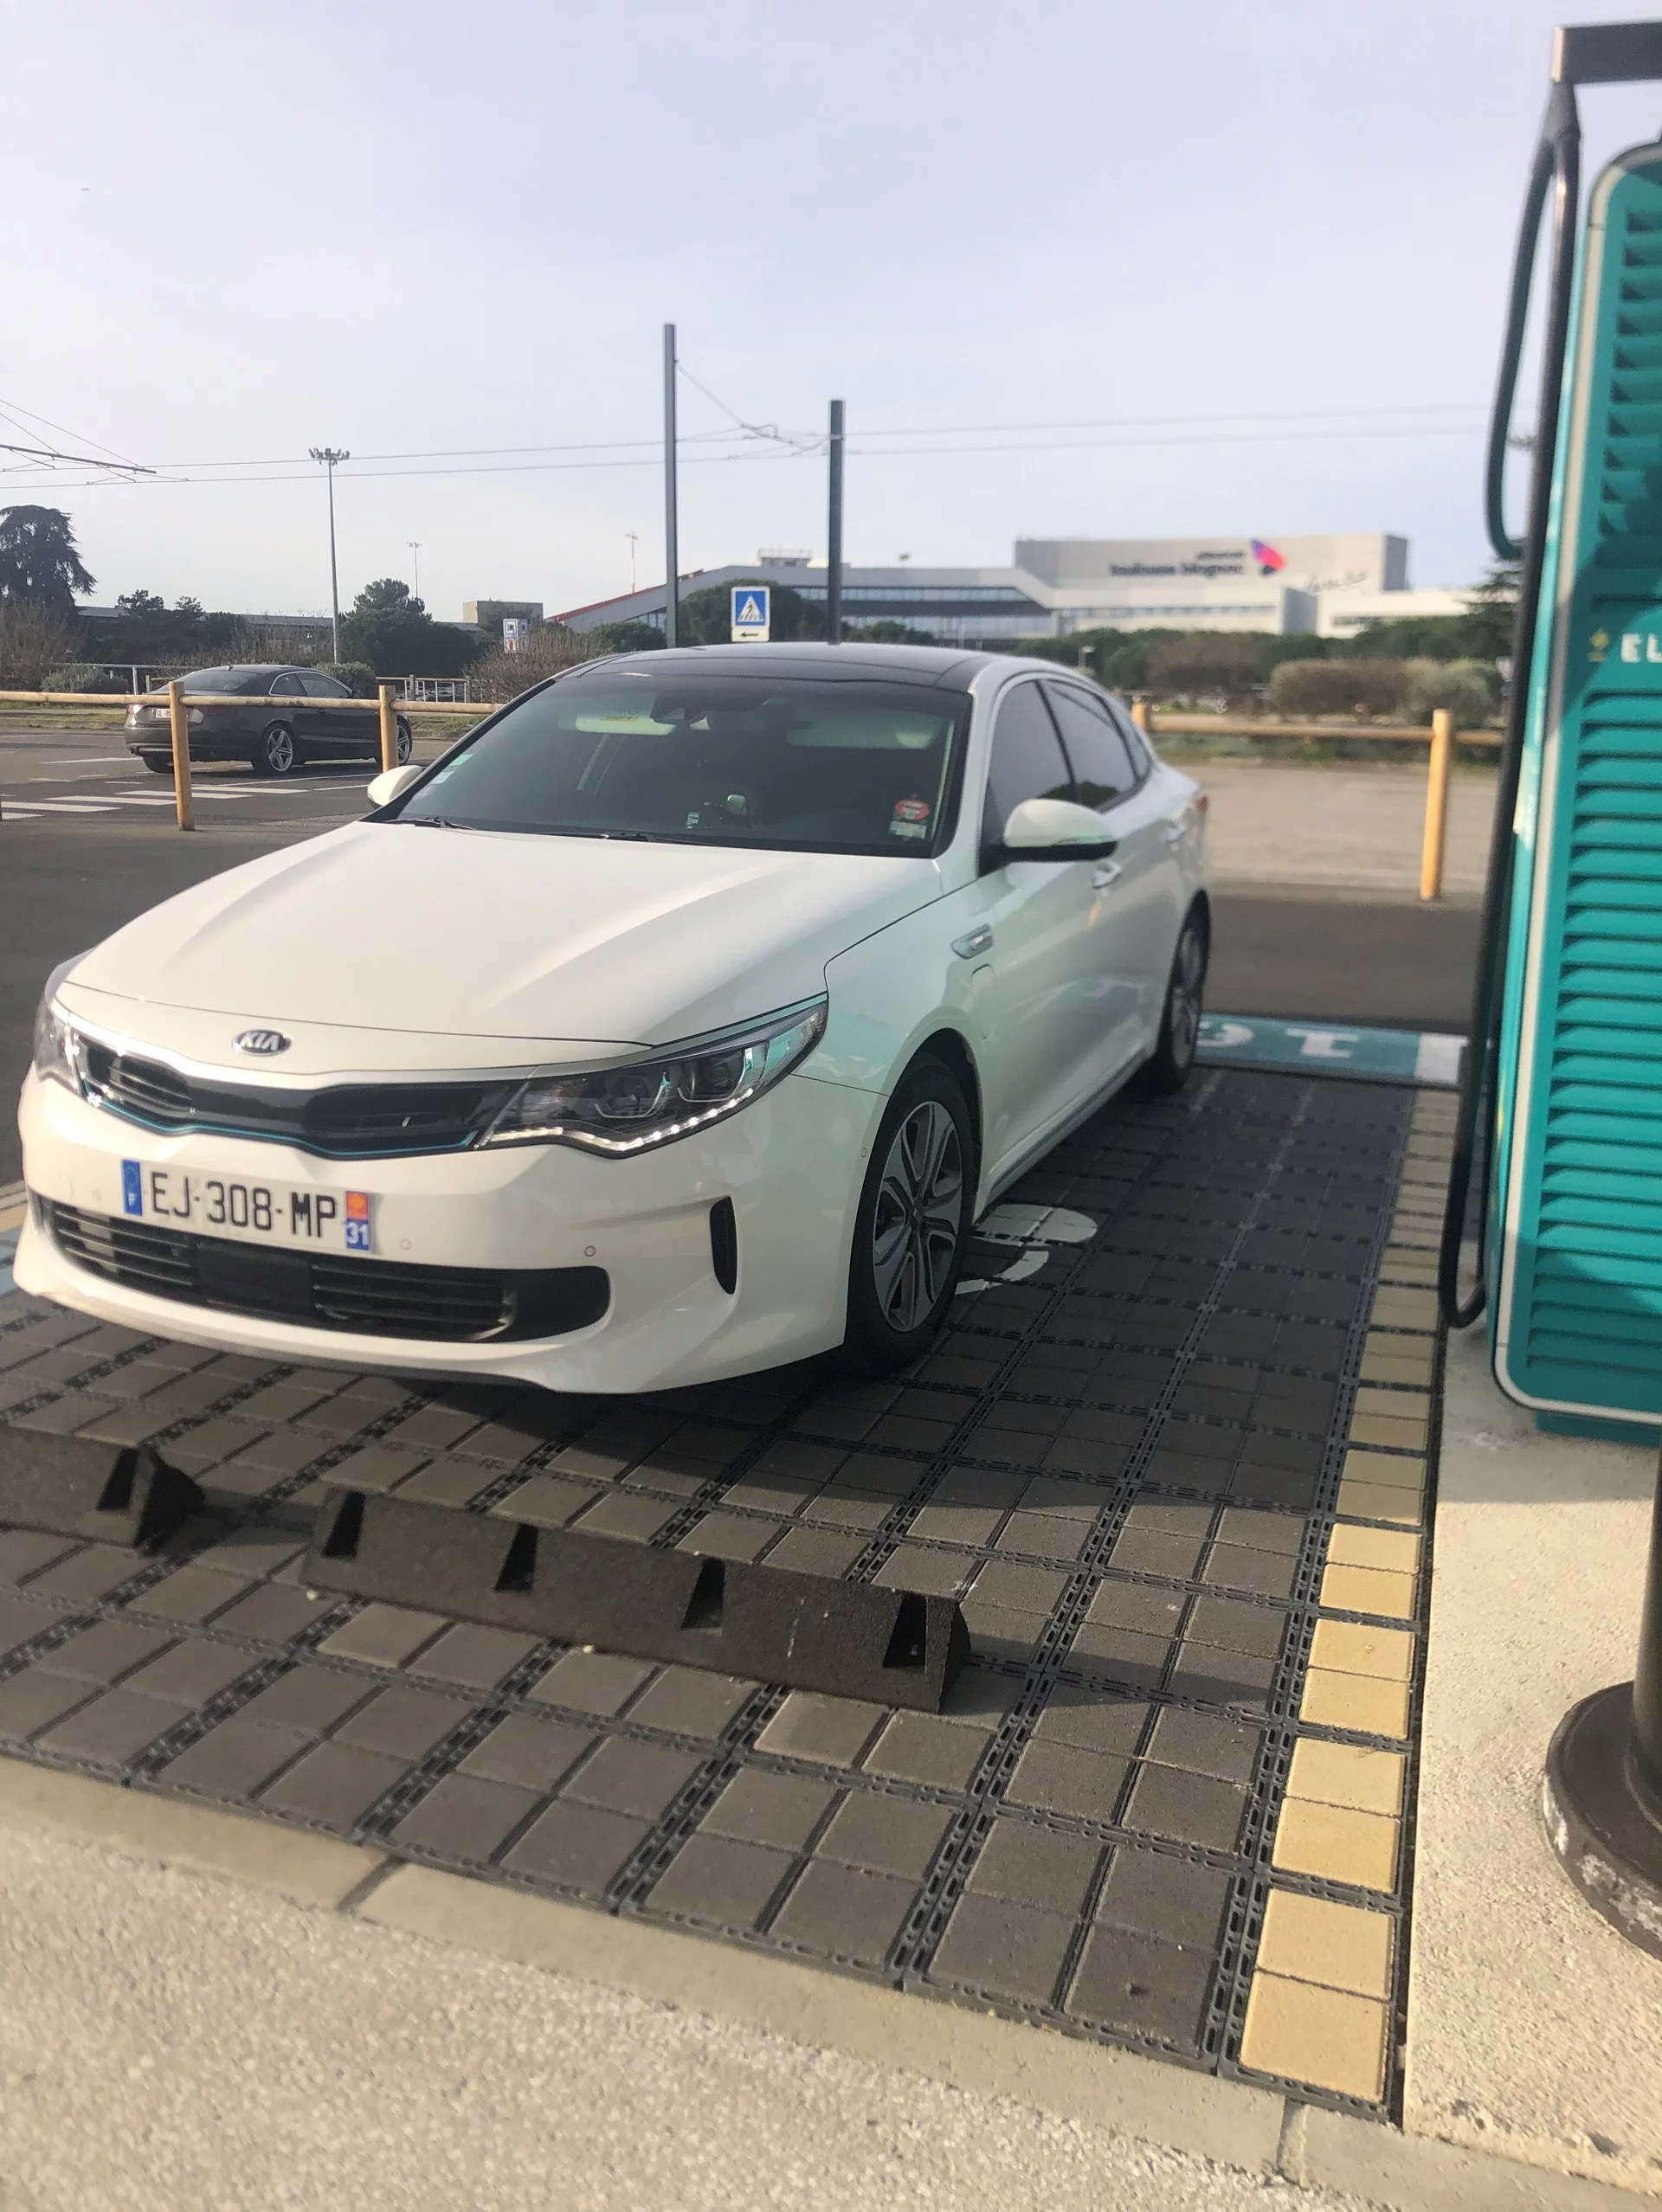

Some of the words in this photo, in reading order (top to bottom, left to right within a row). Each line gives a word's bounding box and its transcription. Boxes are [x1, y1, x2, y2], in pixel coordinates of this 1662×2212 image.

[240, 1032, 280, 1051] KIA
[151, 1170, 337, 1238] EJ-308-MP
[346, 1222, 369, 1245] 31
